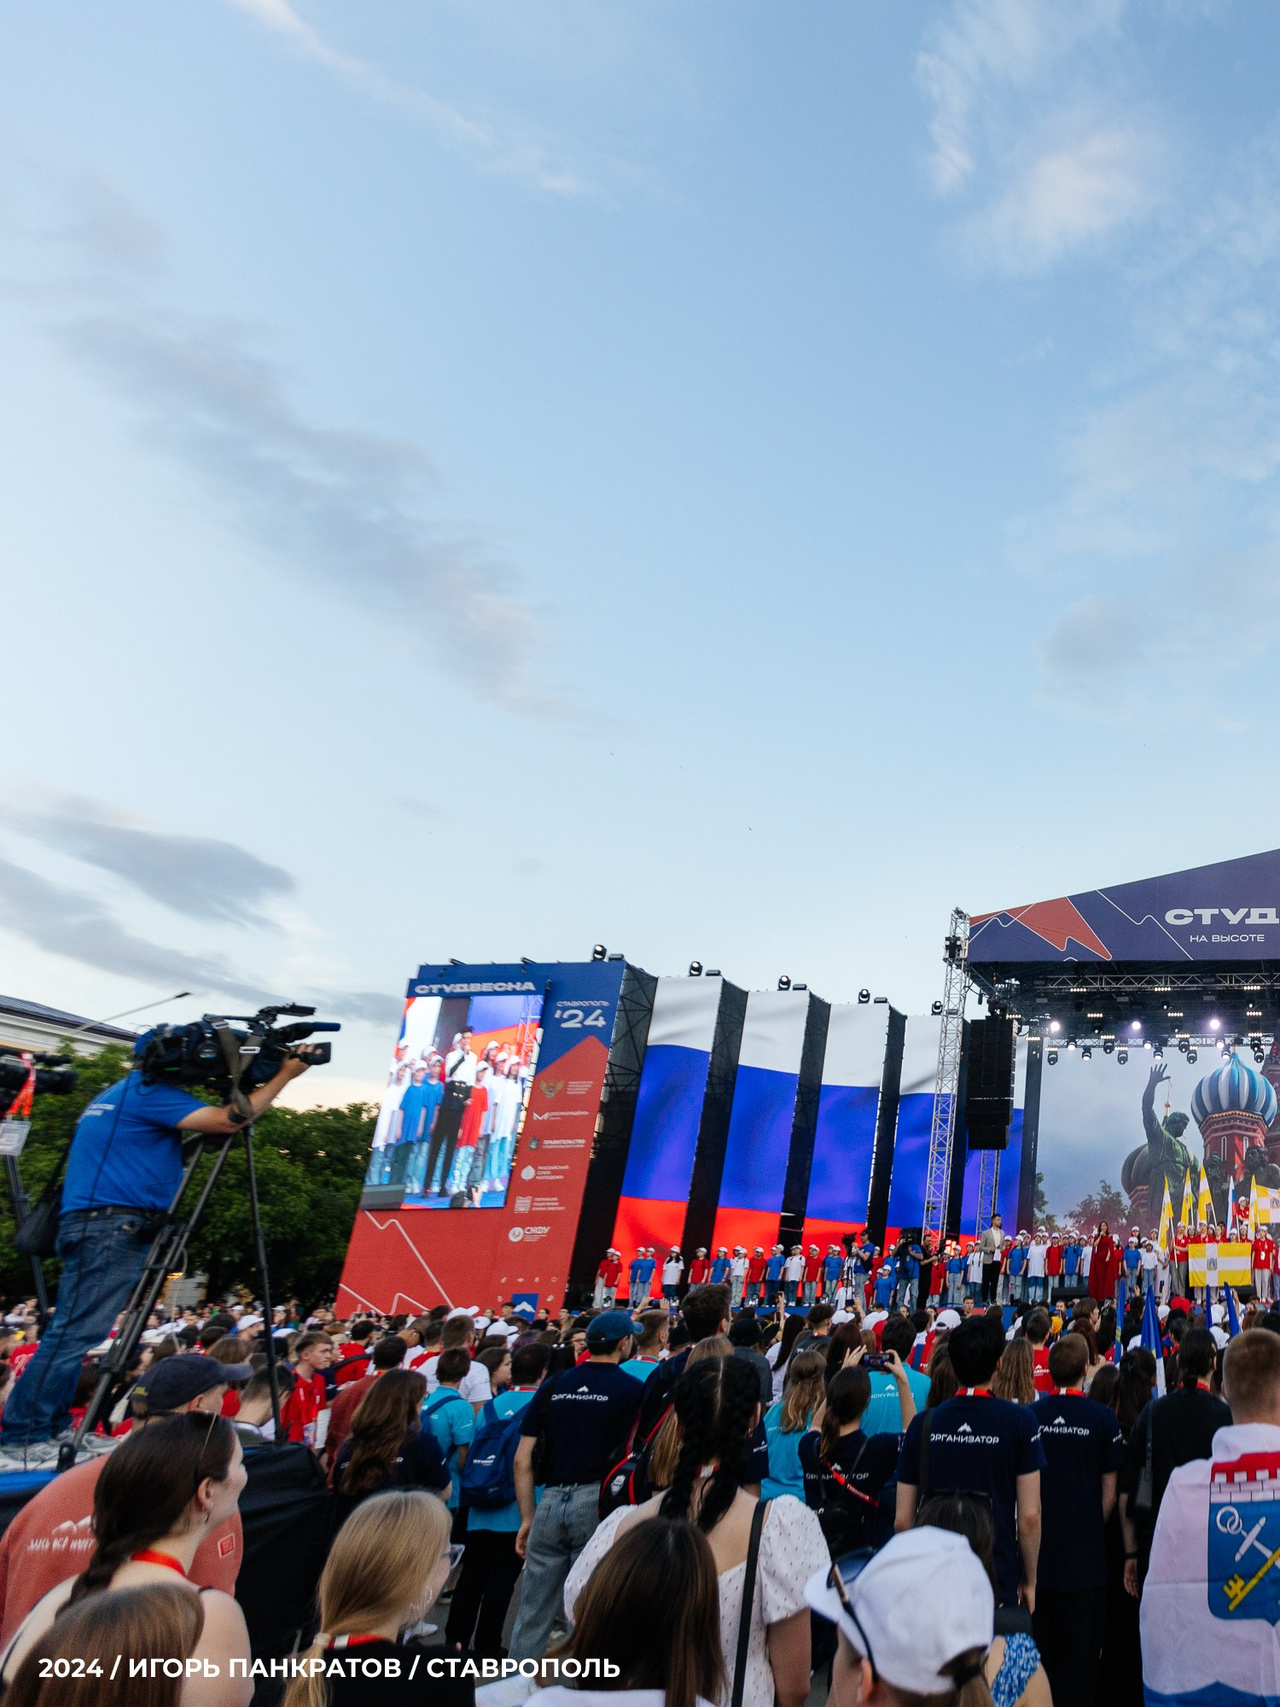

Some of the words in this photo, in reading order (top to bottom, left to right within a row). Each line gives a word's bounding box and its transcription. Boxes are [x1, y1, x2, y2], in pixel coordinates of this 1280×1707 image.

[1189, 934, 1208, 943] НА
[1211, 933, 1266, 943] ВЫСОТЕ
[414, 981, 536, 994] СТУДВЕСНА
[556, 1000, 610, 1008] СТАВРОПОЛЬ
[553, 1008, 608, 1029] '24
[551, 1393, 609, 1402] ОРГАНИЗАТОР
